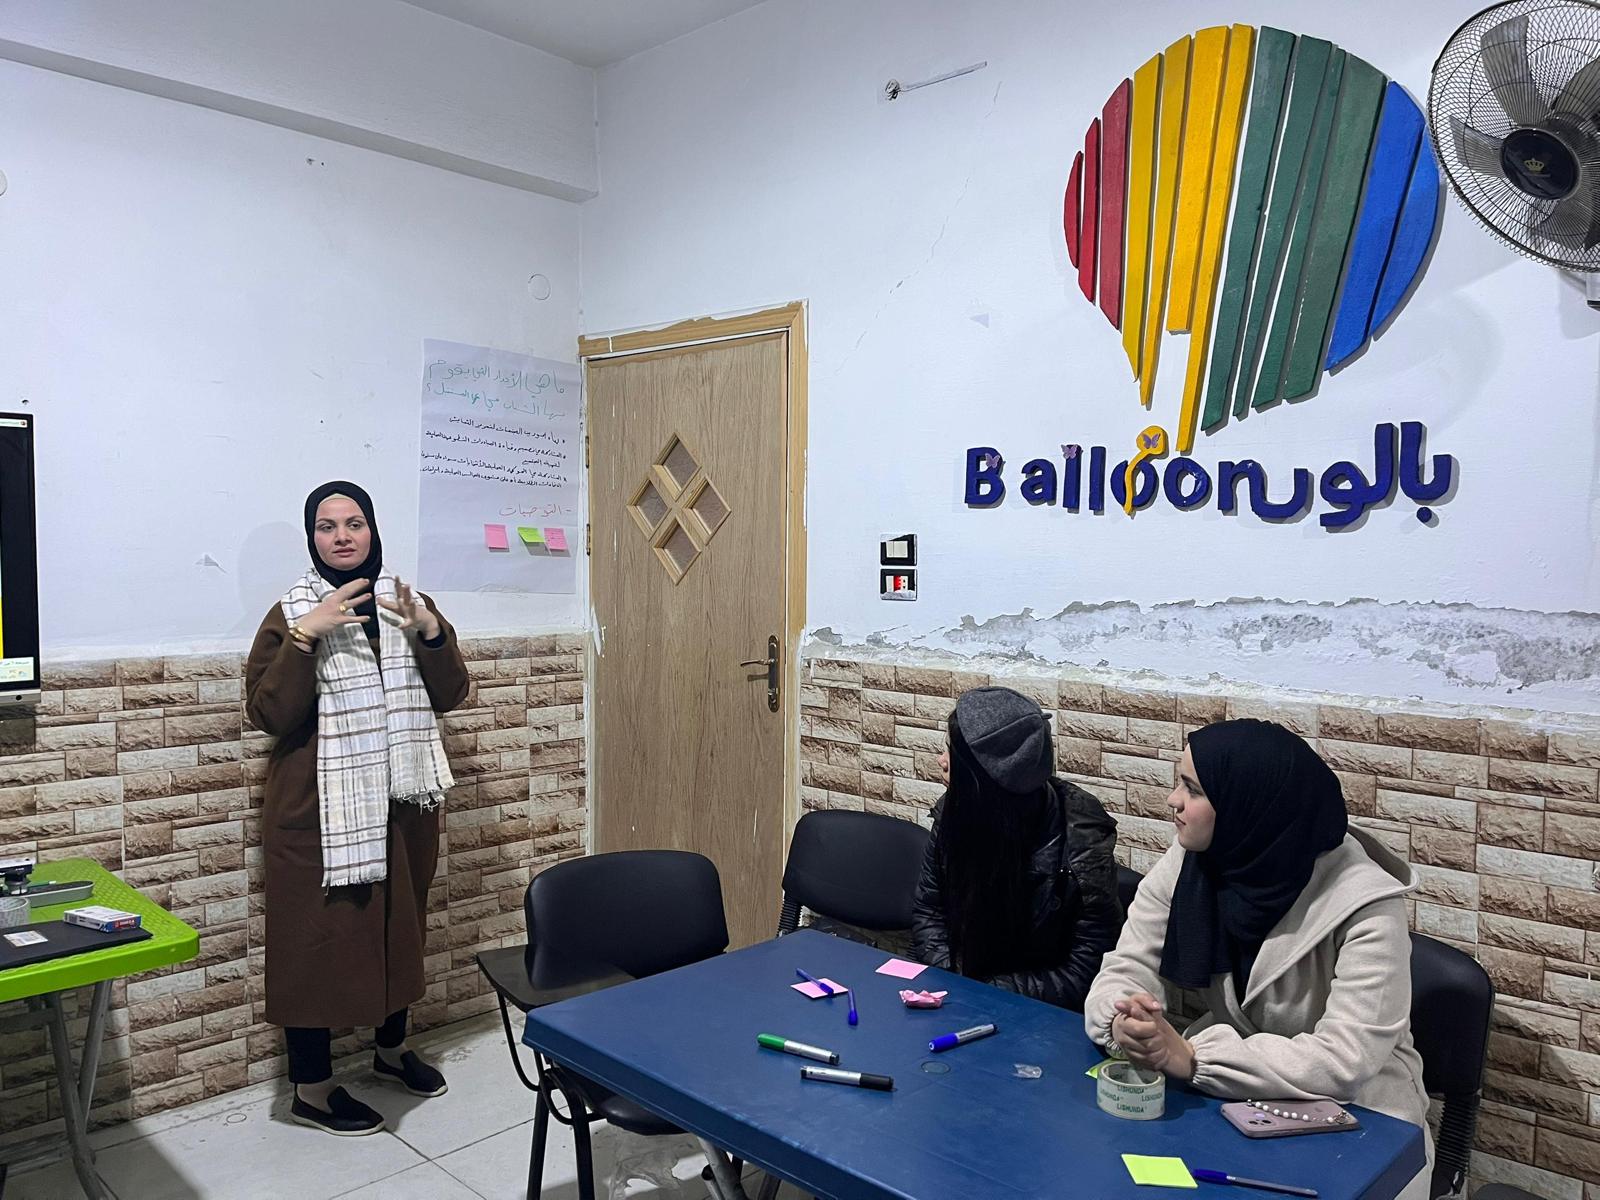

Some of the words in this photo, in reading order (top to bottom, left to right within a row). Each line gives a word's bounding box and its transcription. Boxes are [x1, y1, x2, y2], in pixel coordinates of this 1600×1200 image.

[428, 359, 470, 381] يقوم
[472, 365, 491, 382] التي
[964, 444, 1262, 516] Balloon
